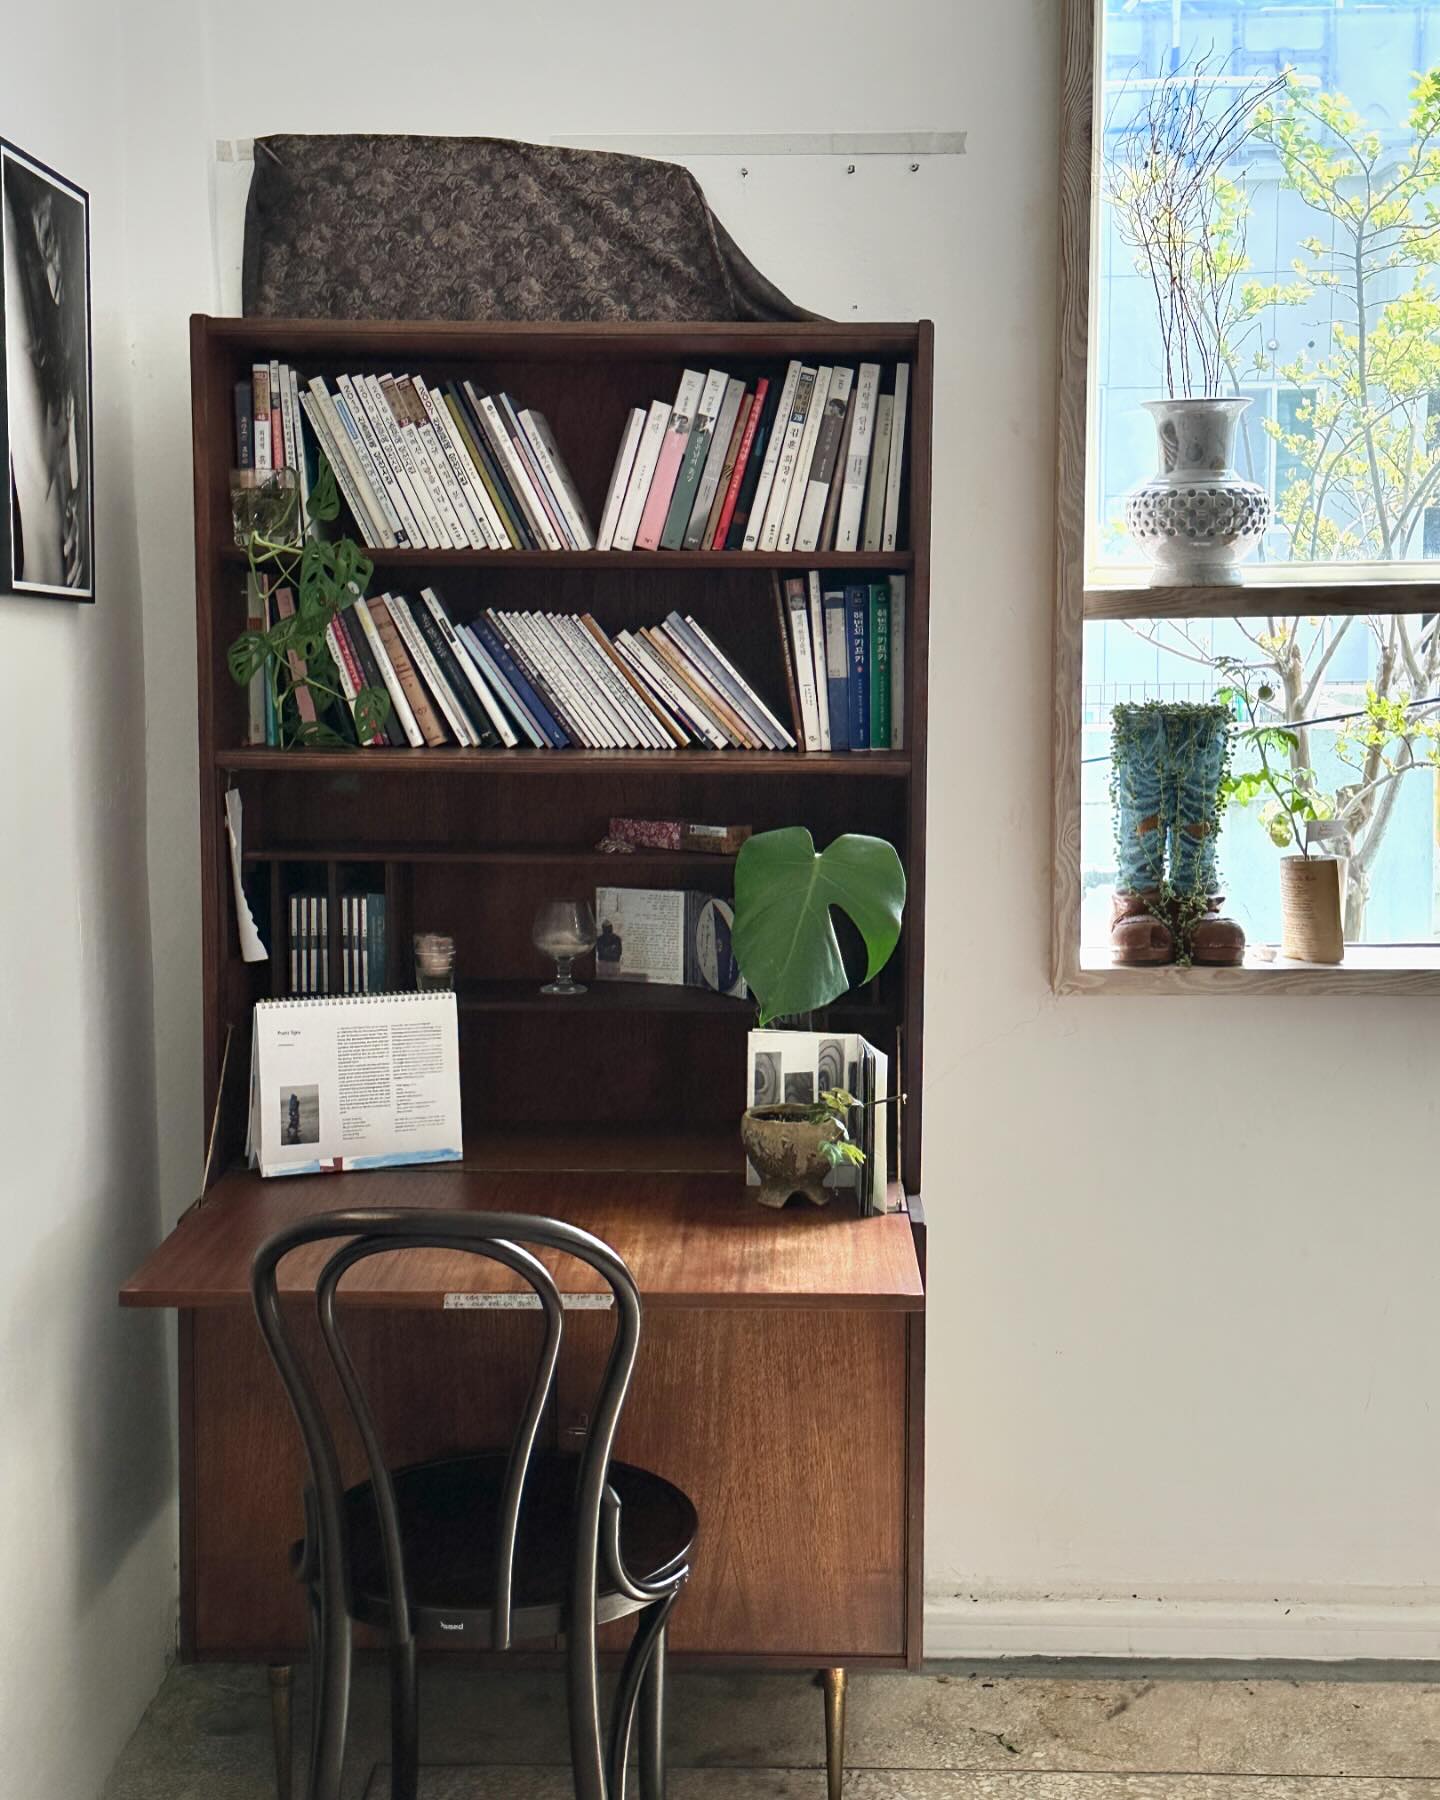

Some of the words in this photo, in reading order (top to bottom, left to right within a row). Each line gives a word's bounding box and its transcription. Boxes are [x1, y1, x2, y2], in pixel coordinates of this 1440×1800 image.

[418, 386, 435, 415] 2007
[853, 611, 865, 636] 해변의
[876, 608, 888, 634] 해변의
[854, 638, 865, 664] 카프카
[877, 636, 888, 662] 카프카
